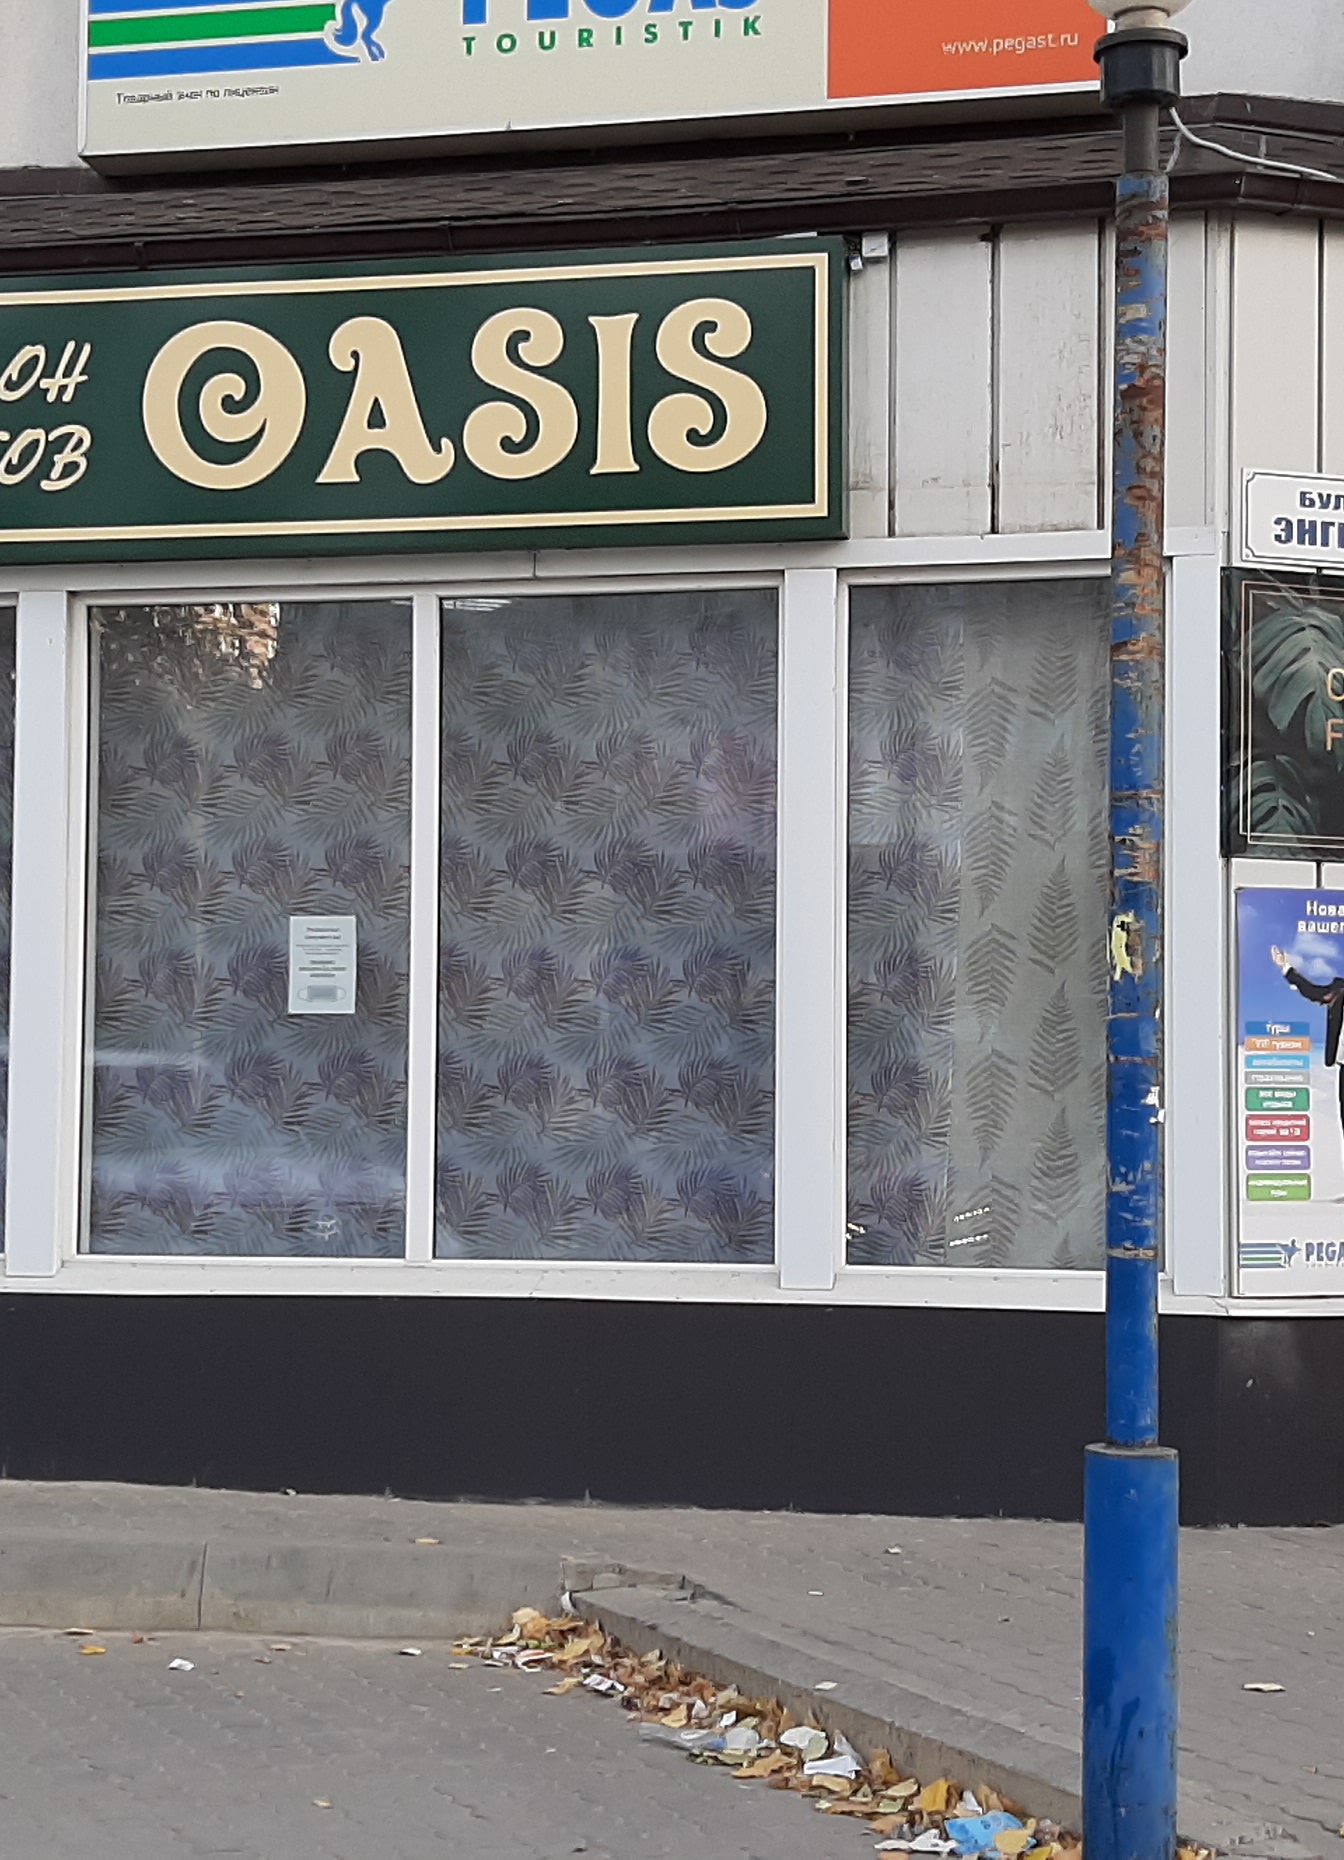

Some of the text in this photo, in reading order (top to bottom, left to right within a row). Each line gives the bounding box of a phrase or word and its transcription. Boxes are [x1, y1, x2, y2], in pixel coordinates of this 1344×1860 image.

[462, 16, 762, 56] TOURISTIK
[942, 33, 1079, 56] www.pegast.ru
[142, 298, 767, 491] OASIS
